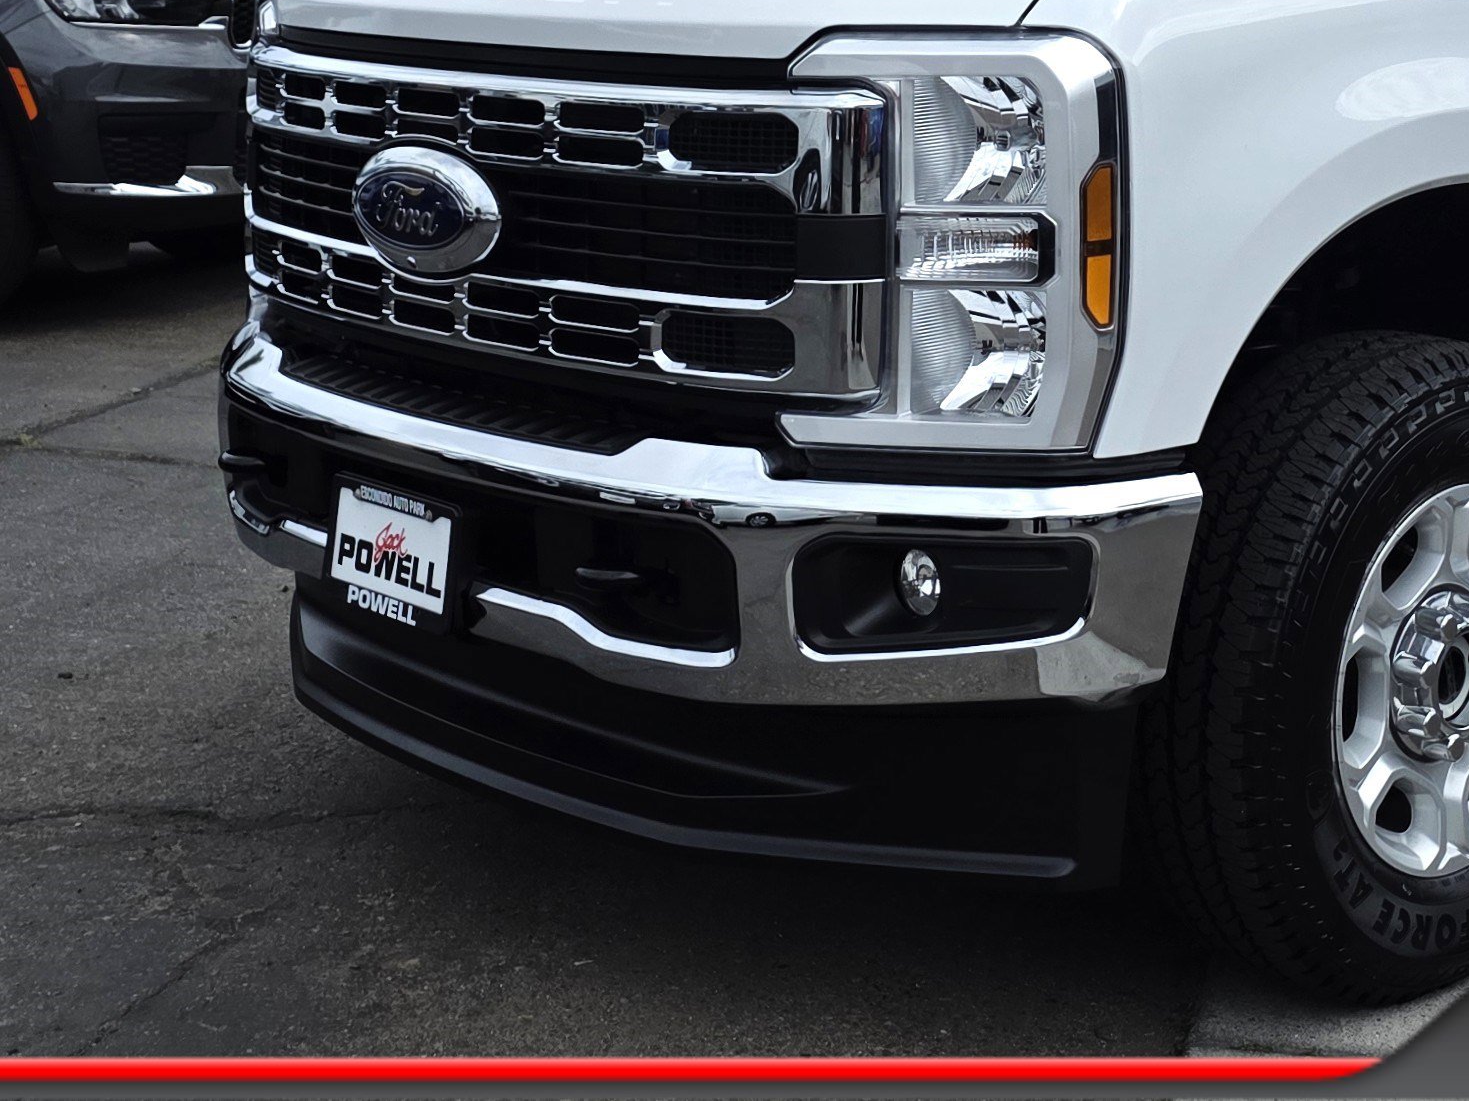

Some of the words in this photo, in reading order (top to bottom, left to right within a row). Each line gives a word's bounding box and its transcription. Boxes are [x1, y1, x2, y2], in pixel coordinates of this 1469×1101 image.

[375, 180, 441, 237] Ford
[394, 497, 408, 513] AUTO
[410, 500, 425, 516] PARK
[373, 522, 408, 565] Jack
[338, 533, 441, 598] POWELL
[347, 585, 416, 626] POWELL
